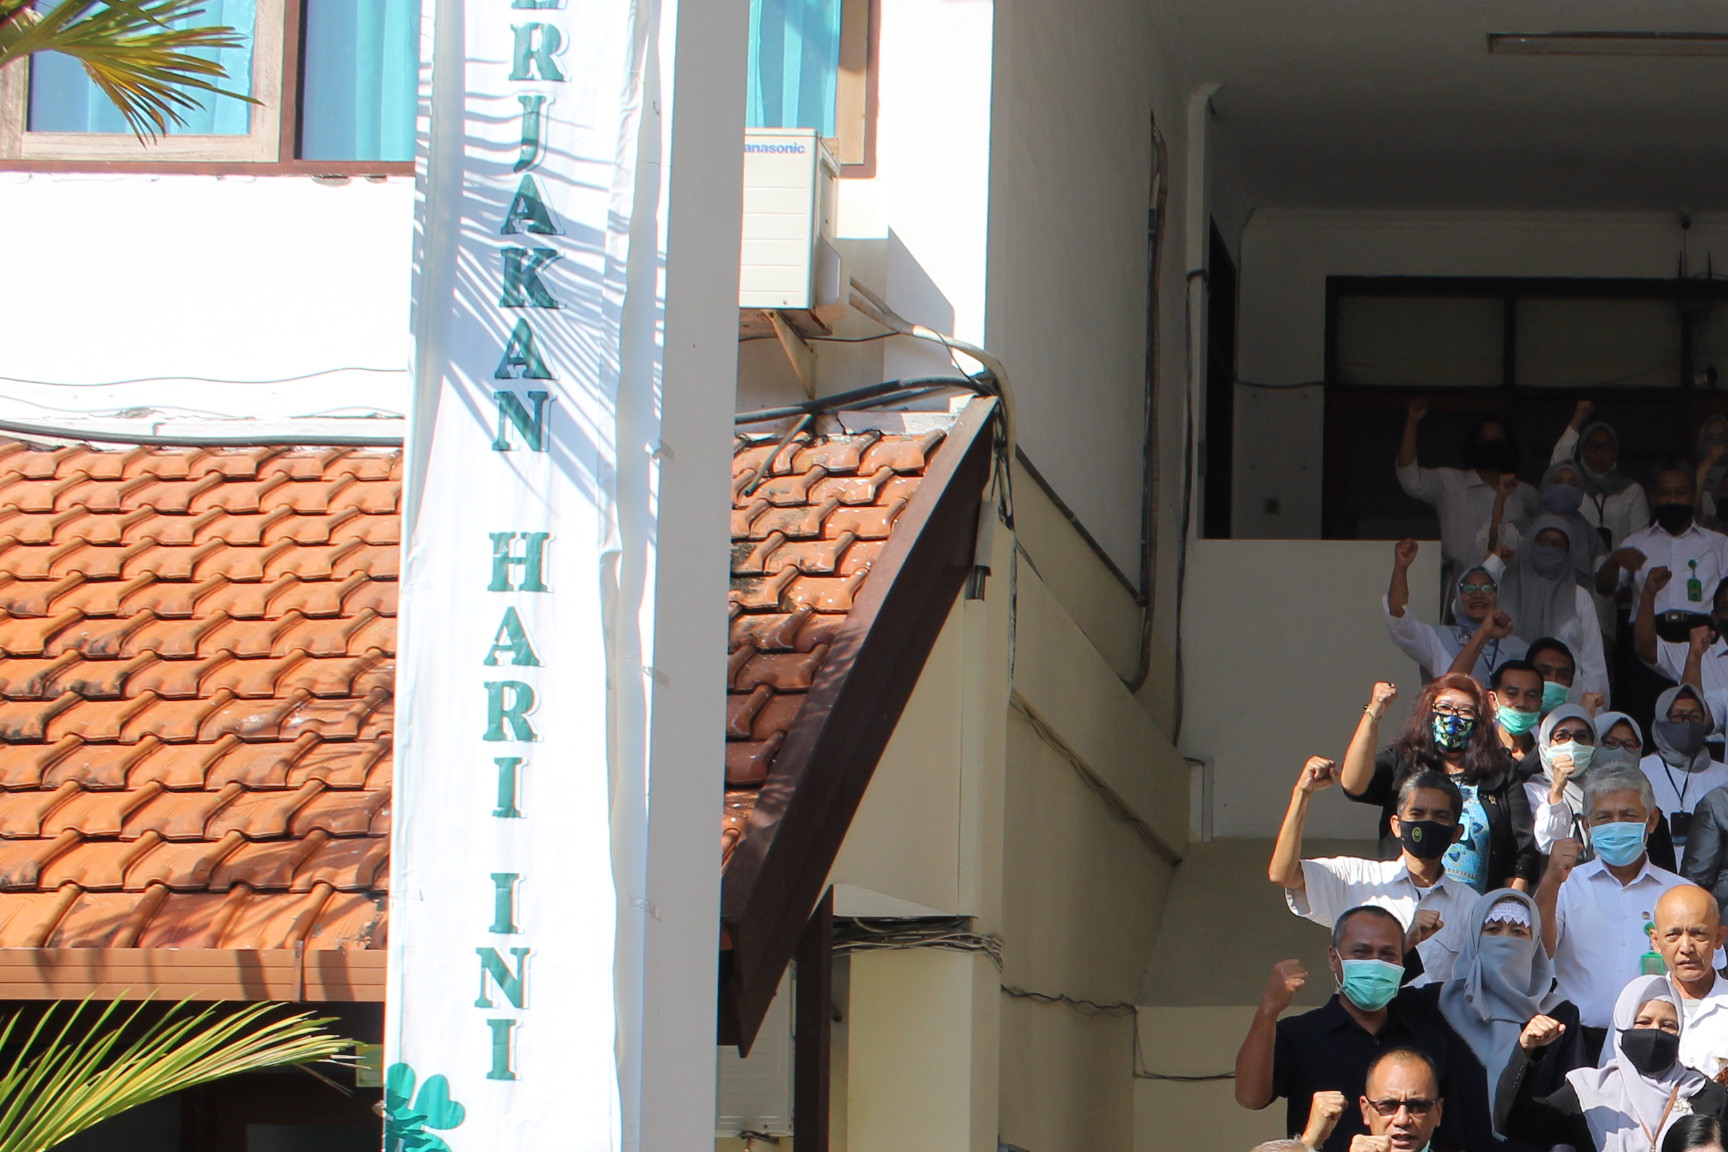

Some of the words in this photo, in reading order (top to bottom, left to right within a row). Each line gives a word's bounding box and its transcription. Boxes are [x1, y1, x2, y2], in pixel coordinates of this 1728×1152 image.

[493, 0, 567, 452] RJAKAN
[483, 532, 549, 819] HARI
[474, 872, 534, 1081] INI
